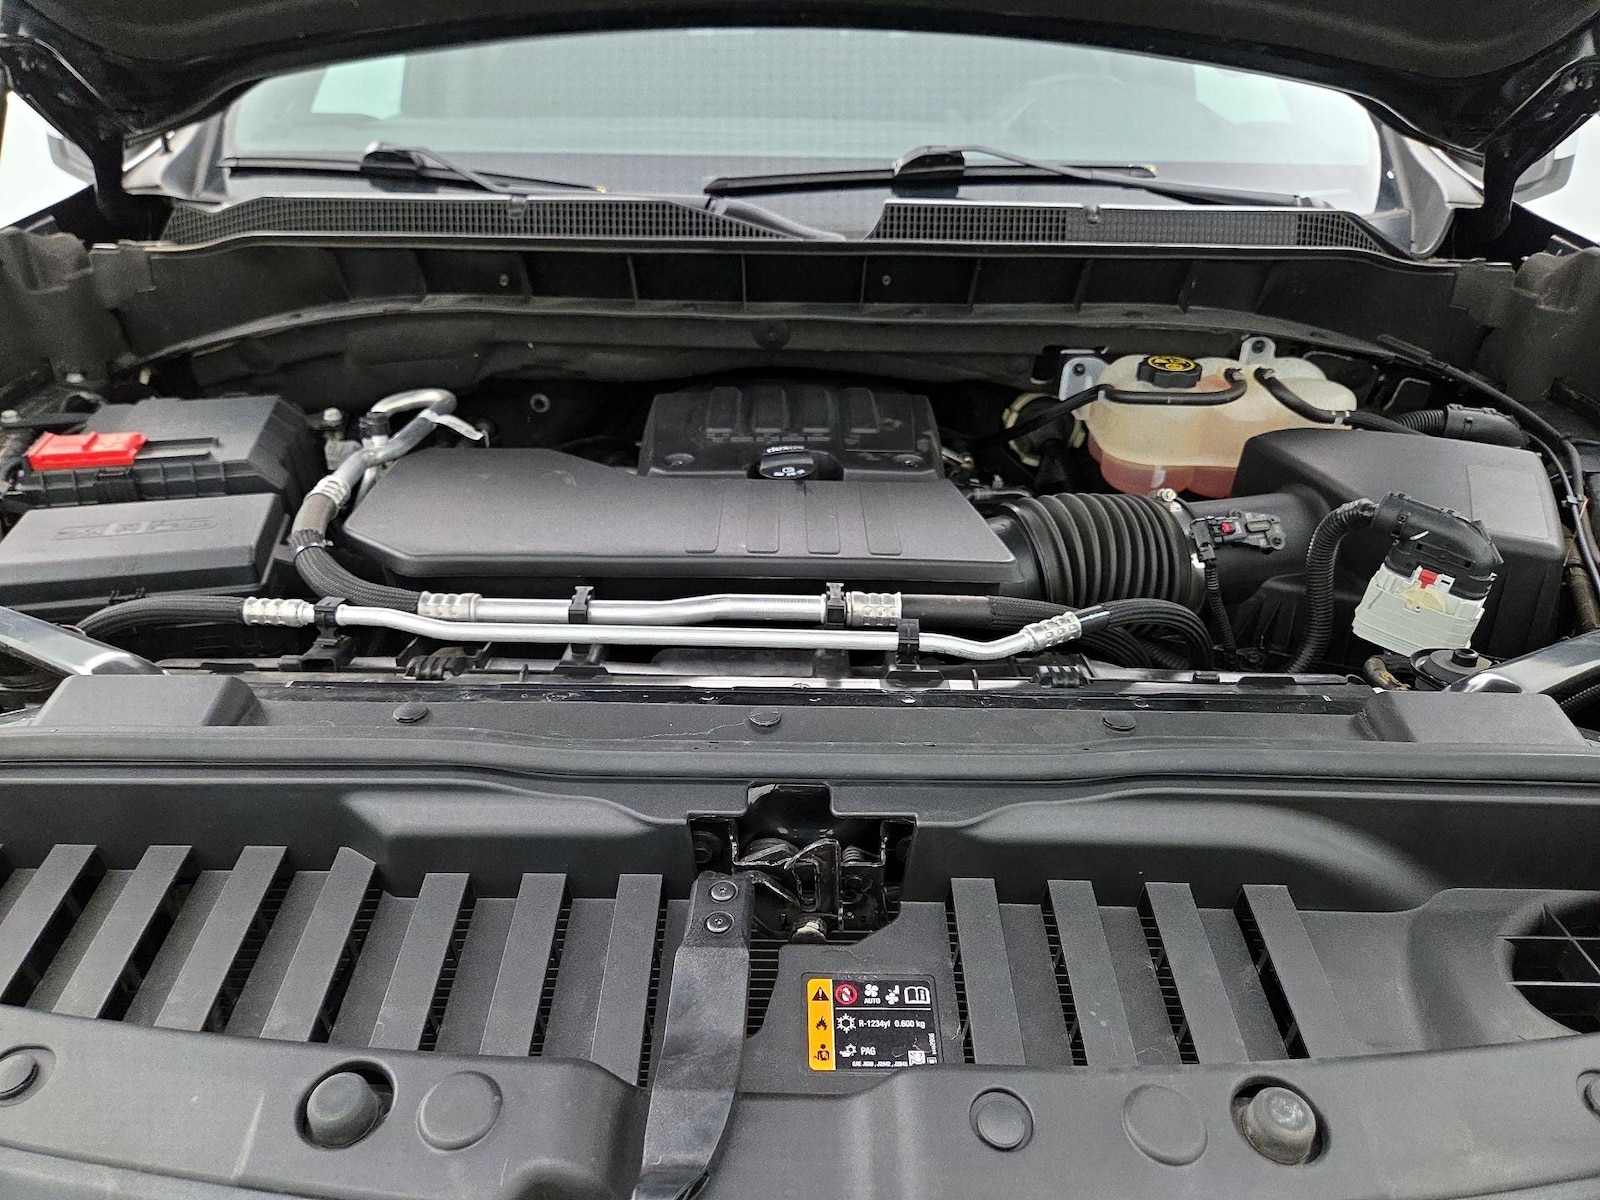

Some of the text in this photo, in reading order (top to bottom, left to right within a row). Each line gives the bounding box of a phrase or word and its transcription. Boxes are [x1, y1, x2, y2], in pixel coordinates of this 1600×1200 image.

[858, 1019, 926, 1030] R-1234yf 0.600 kg
[860, 1046, 877, 1056] PAG
